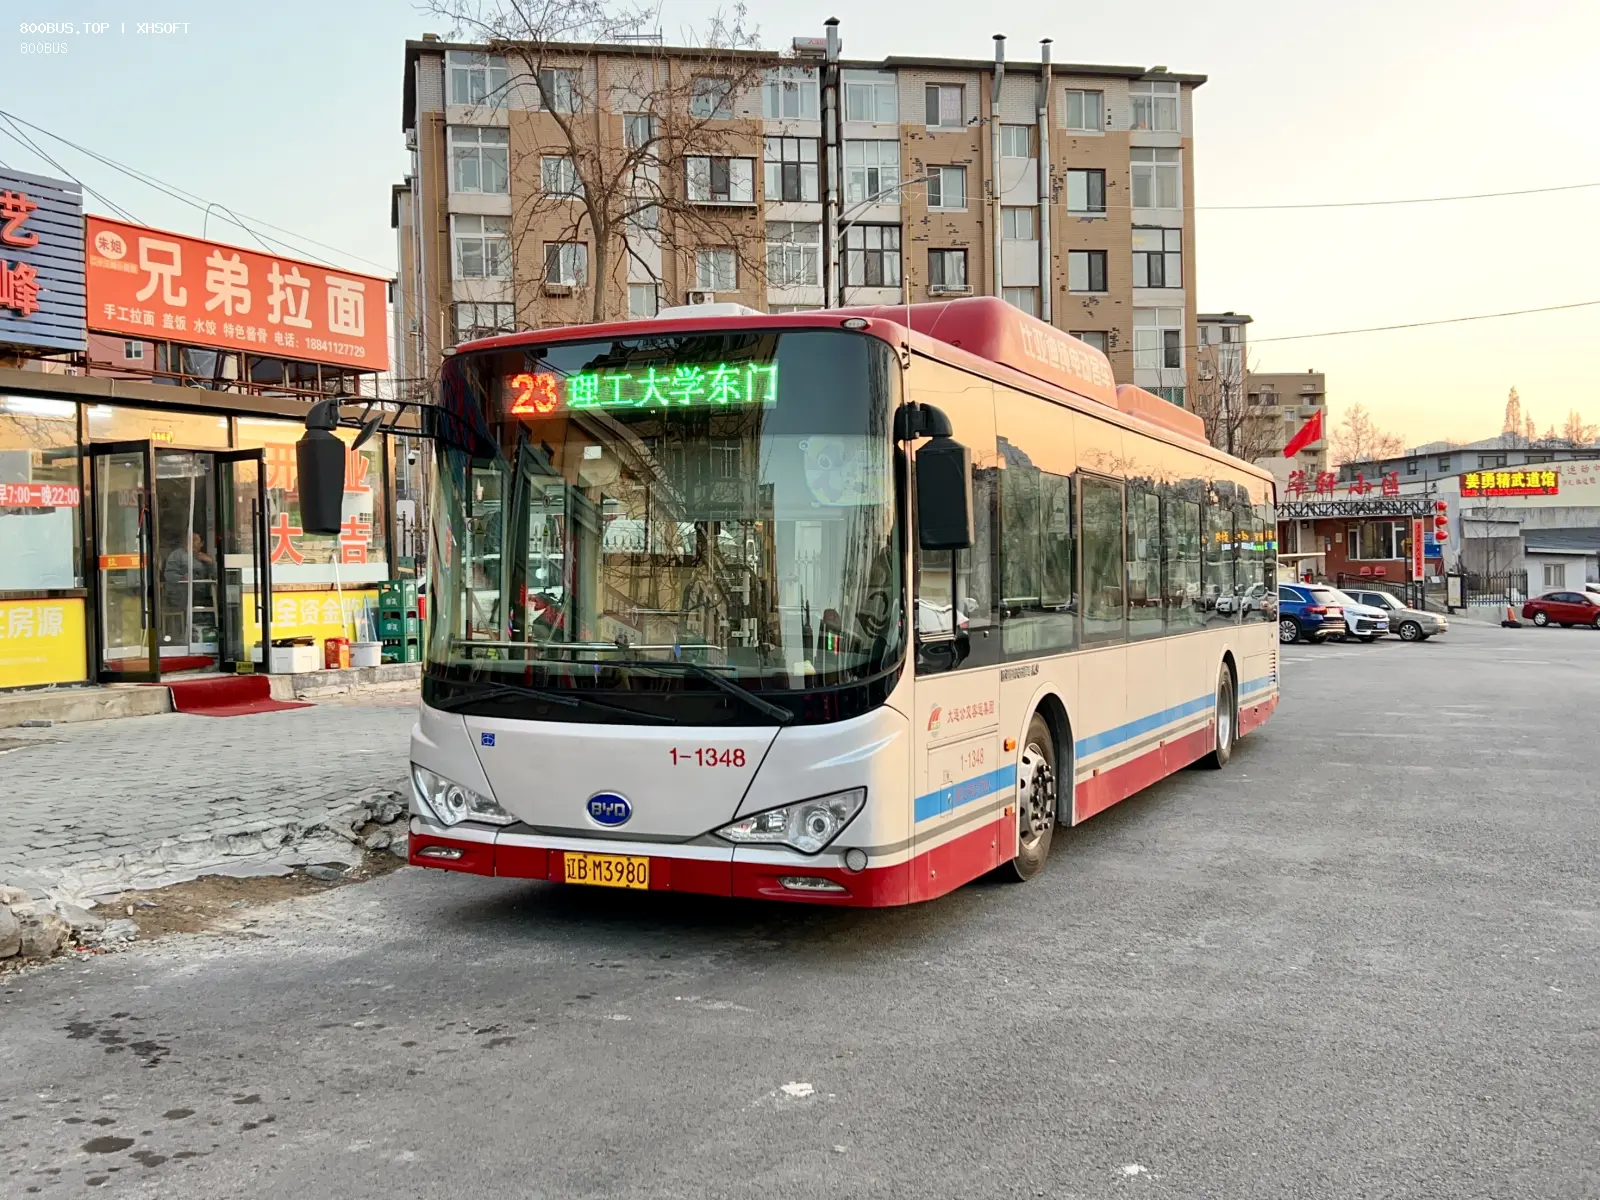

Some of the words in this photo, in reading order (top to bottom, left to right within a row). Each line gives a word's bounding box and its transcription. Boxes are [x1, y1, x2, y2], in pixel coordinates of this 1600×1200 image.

[136, 236, 366, 338] 兄弟拉面
[103, 303, 156, 326] 手工拉面
[162, 313, 187, 332] 盖饭
[193, 318, 217, 337] 水饺
[223, 322, 268, 344] 特色酱骨
[305, 337, 366, 358] 18841127729
[511, 373, 557, 414] 23
[566, 362, 778, 408] 理工大学东门
[1464, 471, 1556, 489] 姜勇精武道馆
[270, 513, 371, 565] 大吉
[0, 606, 65, 638] 房源
[669, 748, 746, 767] 1-1348
[961, 748, 984, 770] 1-1348
[591, 801, 626, 817] BYD
